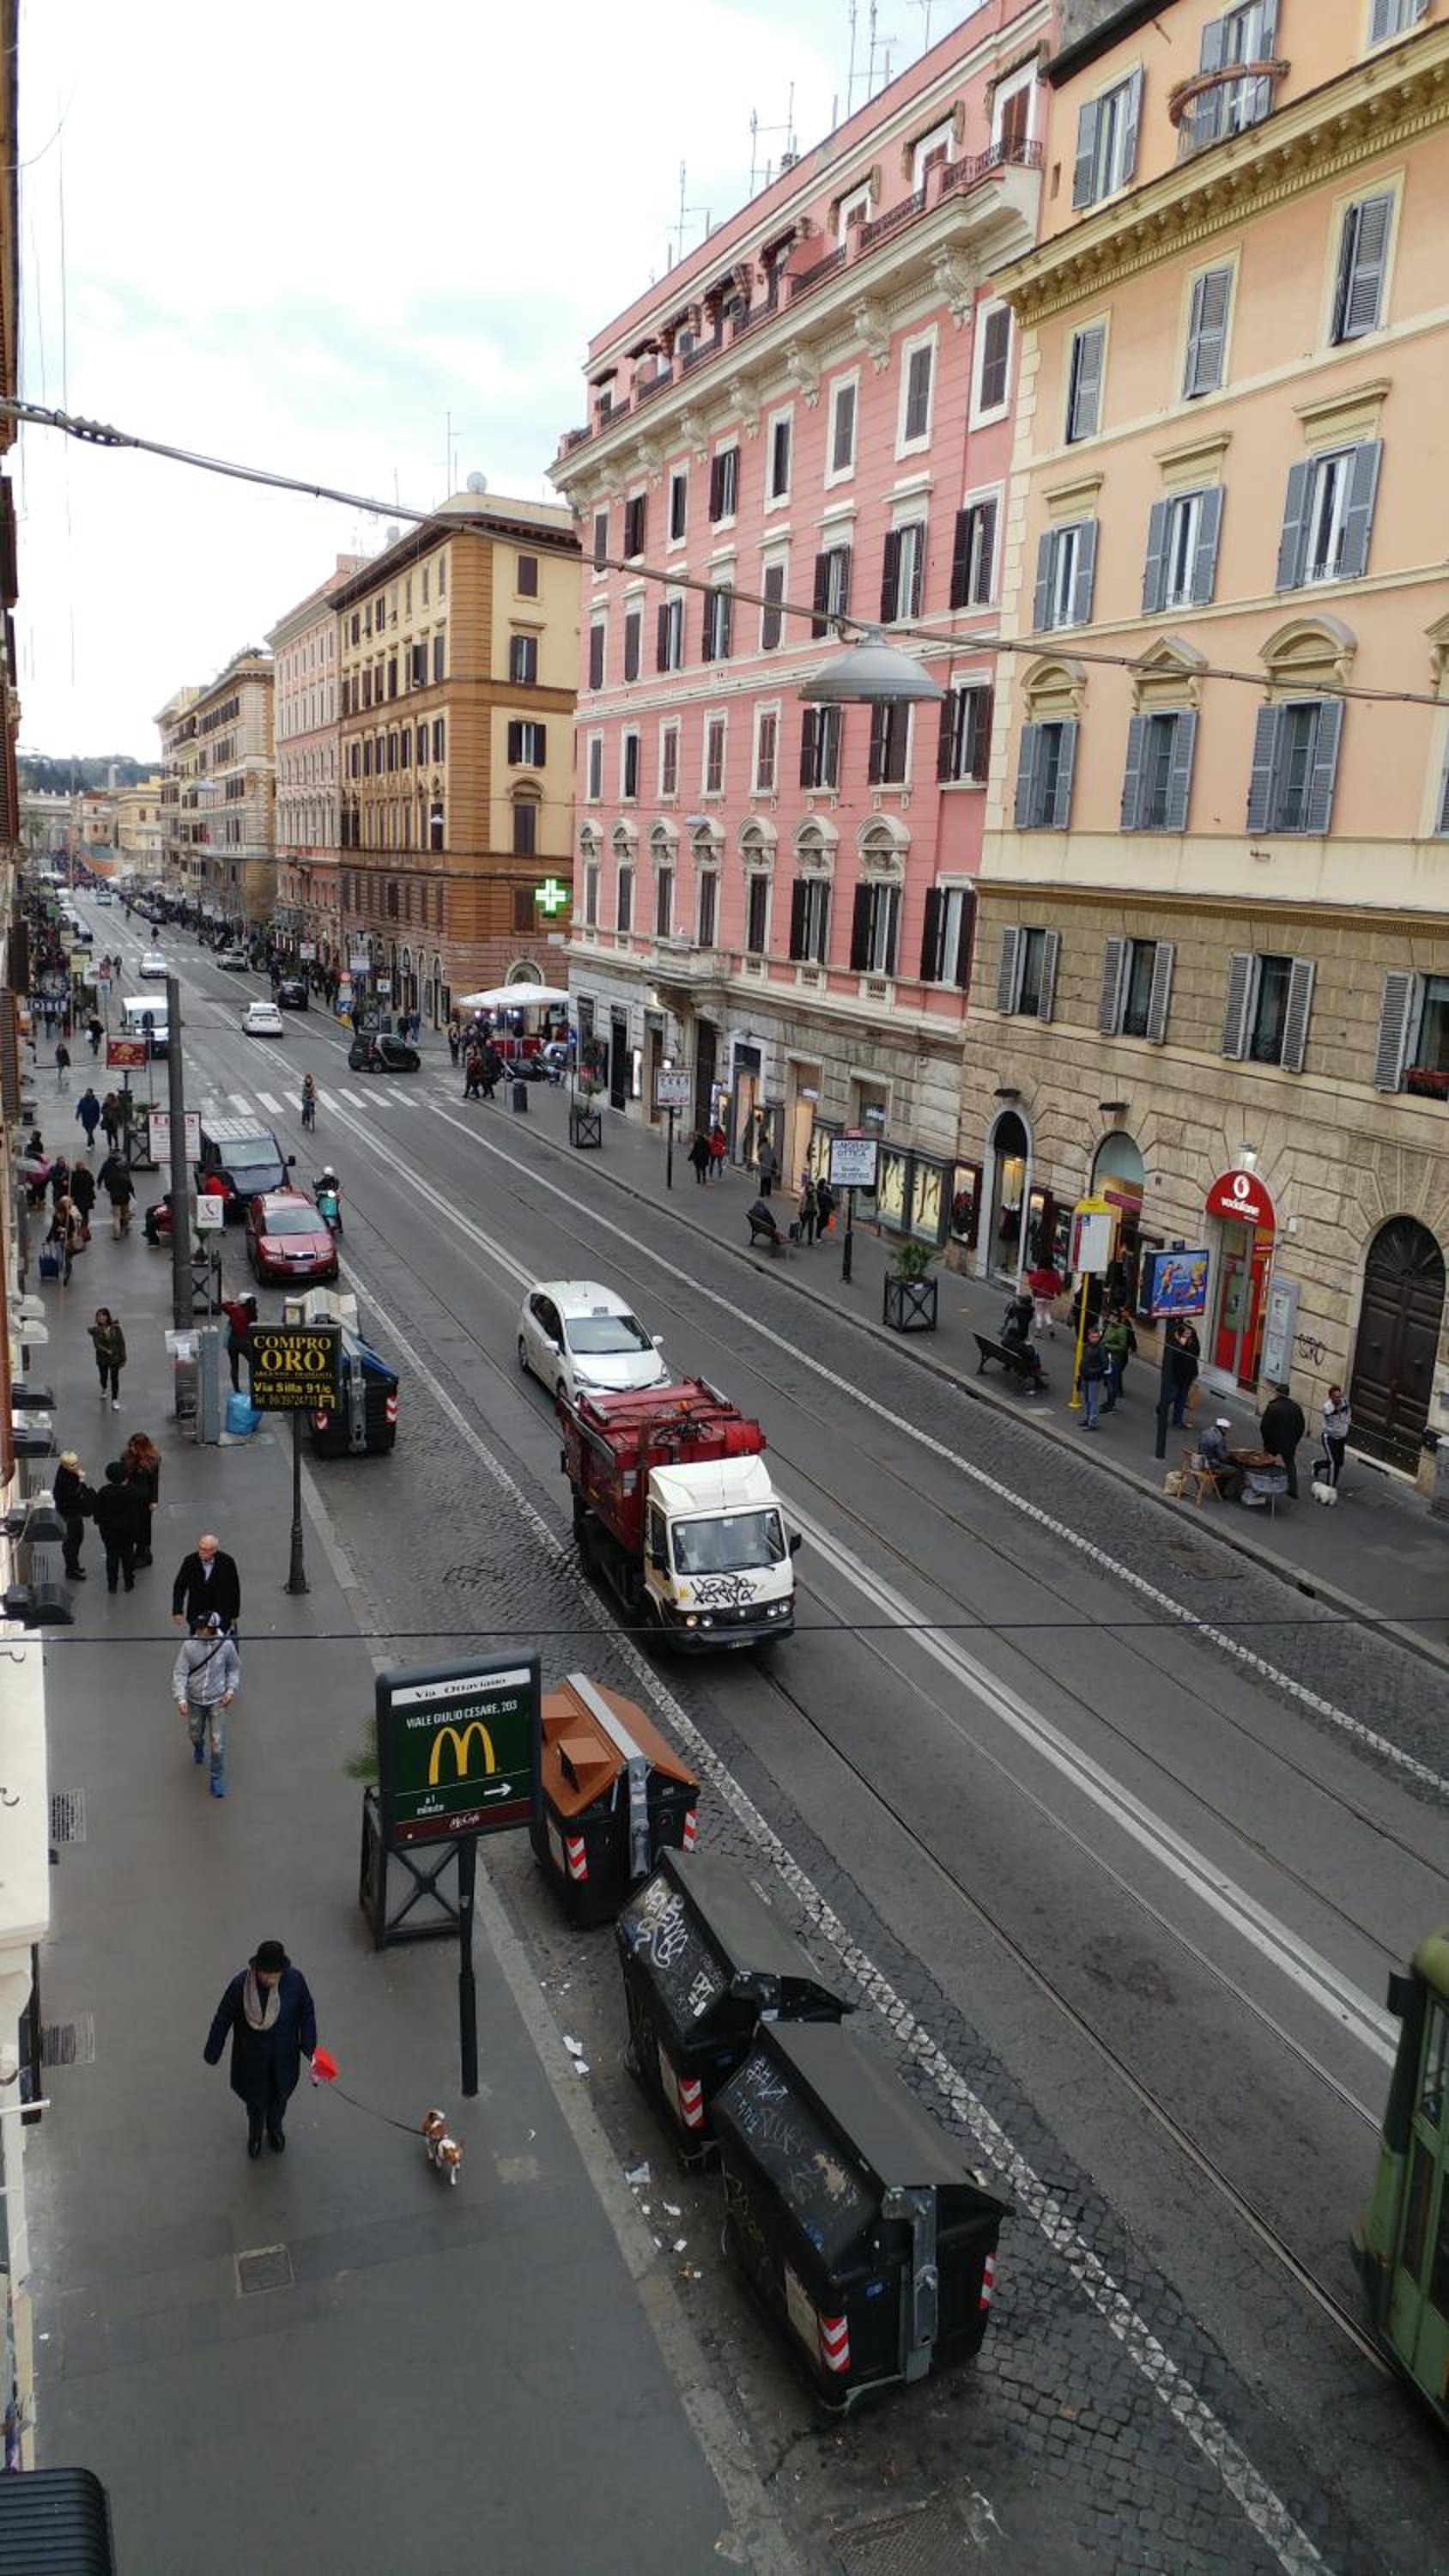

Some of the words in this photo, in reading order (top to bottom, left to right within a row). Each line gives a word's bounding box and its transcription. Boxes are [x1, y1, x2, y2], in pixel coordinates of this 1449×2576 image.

[1221, 1196, 1259, 1217] vodafone
[253, 1335, 331, 1349] COMPRO
[260, 1349, 326, 1371] ORO
[253, 1382, 273, 1392] Via
[276, 1382, 303, 1393] Silla
[415, 1689, 436, 1698] Via
[406, 1714, 433, 1729] VIALE
[433, 1709, 463, 1724] GIULIO
